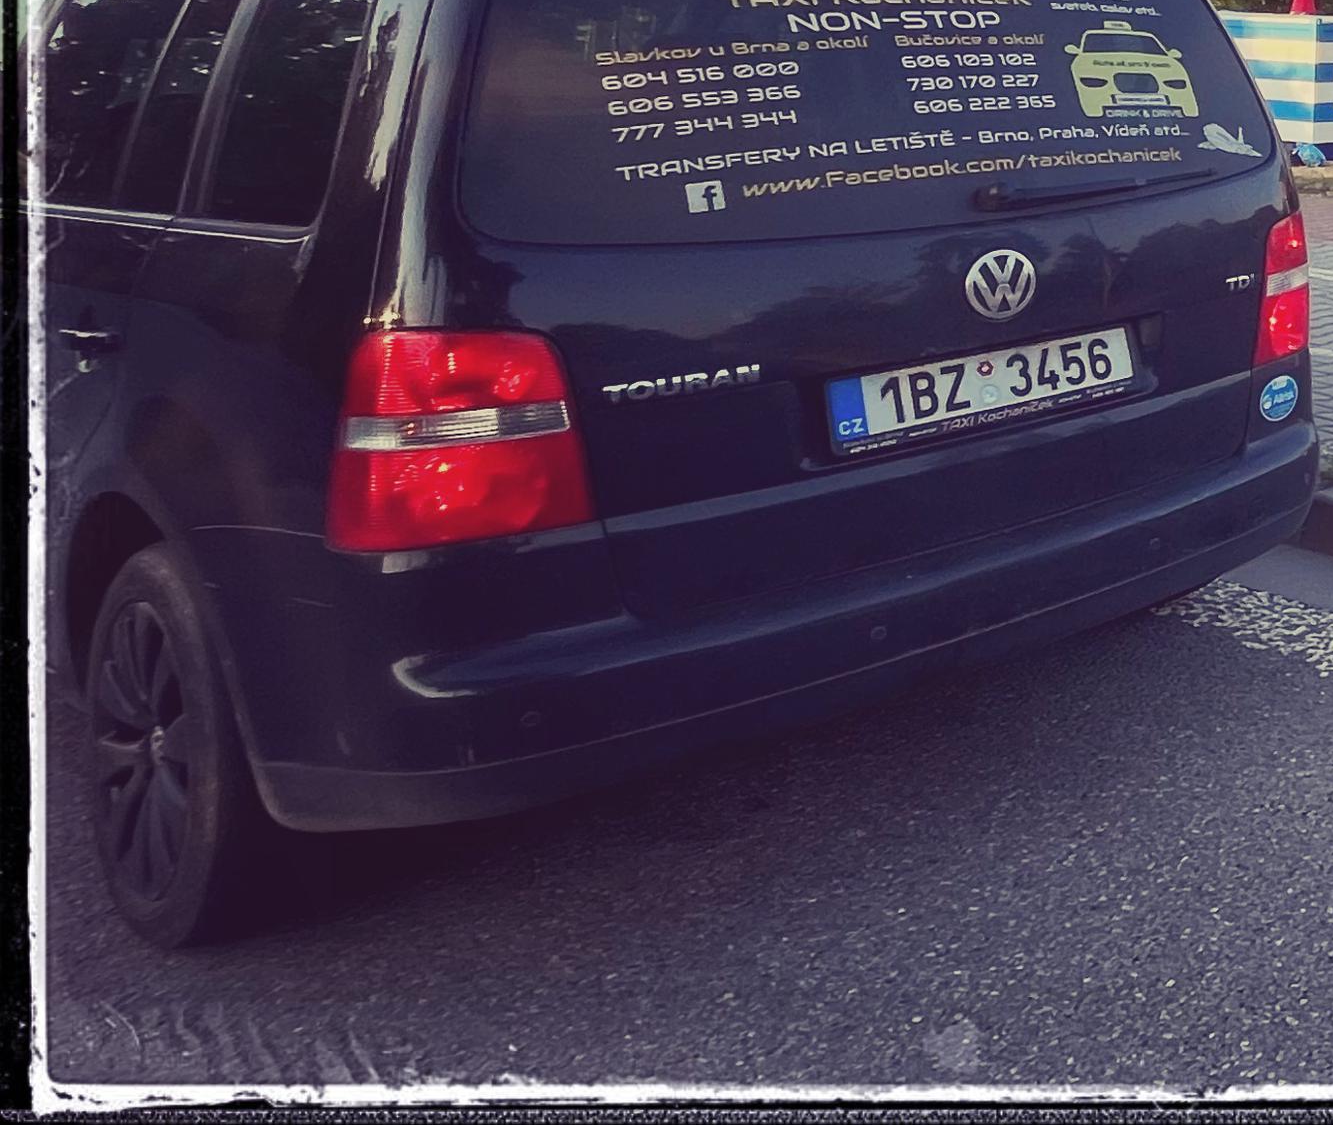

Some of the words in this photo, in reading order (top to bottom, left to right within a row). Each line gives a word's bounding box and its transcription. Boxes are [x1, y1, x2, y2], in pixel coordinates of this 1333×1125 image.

[786, 10, 1001, 33] NON-STOP
[595, 47, 701, 66] Slavkov
[708, 46, 725, 57] u
[731, 41, 790, 55] Brna
[796, 40, 810, 51] a
[815, 35, 869, 50] okolí
[895, 34, 982, 47] Bučovice
[987, 36, 998, 45] a
[1003, 33, 1046, 46] okolí
[602, 70, 668, 90] 604
[676, 66, 725, 83] 516
[732, 61, 800, 79] 000
[901, 54, 951, 69] 606
[954, 53, 995, 67] 103
[998, 53, 1037, 66] 102
[906, 75, 954, 92] 730
[958, 74, 997, 89] 170
[1001, 74, 1040, 88] 227
[607, 96, 674, 116] 606
[681, 90, 739, 108] 553
[746, 84, 801, 102] 366
[913, 99, 964, 114] 606
[968, 97, 1012, 110] 222
[1015, 95, 1057, 109] 365
[611, 123, 665, 143] 777
[674, 115, 734, 136] 344
[741, 109, 798, 129] 344
[614, 145, 801, 182] TRANSFERY
[808, 141, 848, 158] NA
[854, 129, 956, 155] LETIŠTĚ
[977, 128, 1034, 145] Brno,
[1038, 126, 1100, 141] Praha,
[1101, 122, 1151, 138] Vídeň
[742, 146, 1183, 198] www.Facebook.com/taxikochanicek
[601, 363, 761, 403] TOURAN
[879, 362, 972, 425] 1BZ
[1005, 337, 1113, 399] 3456
[838, 417, 866, 436] CZ
[941, 416, 974, 434] TAXI
